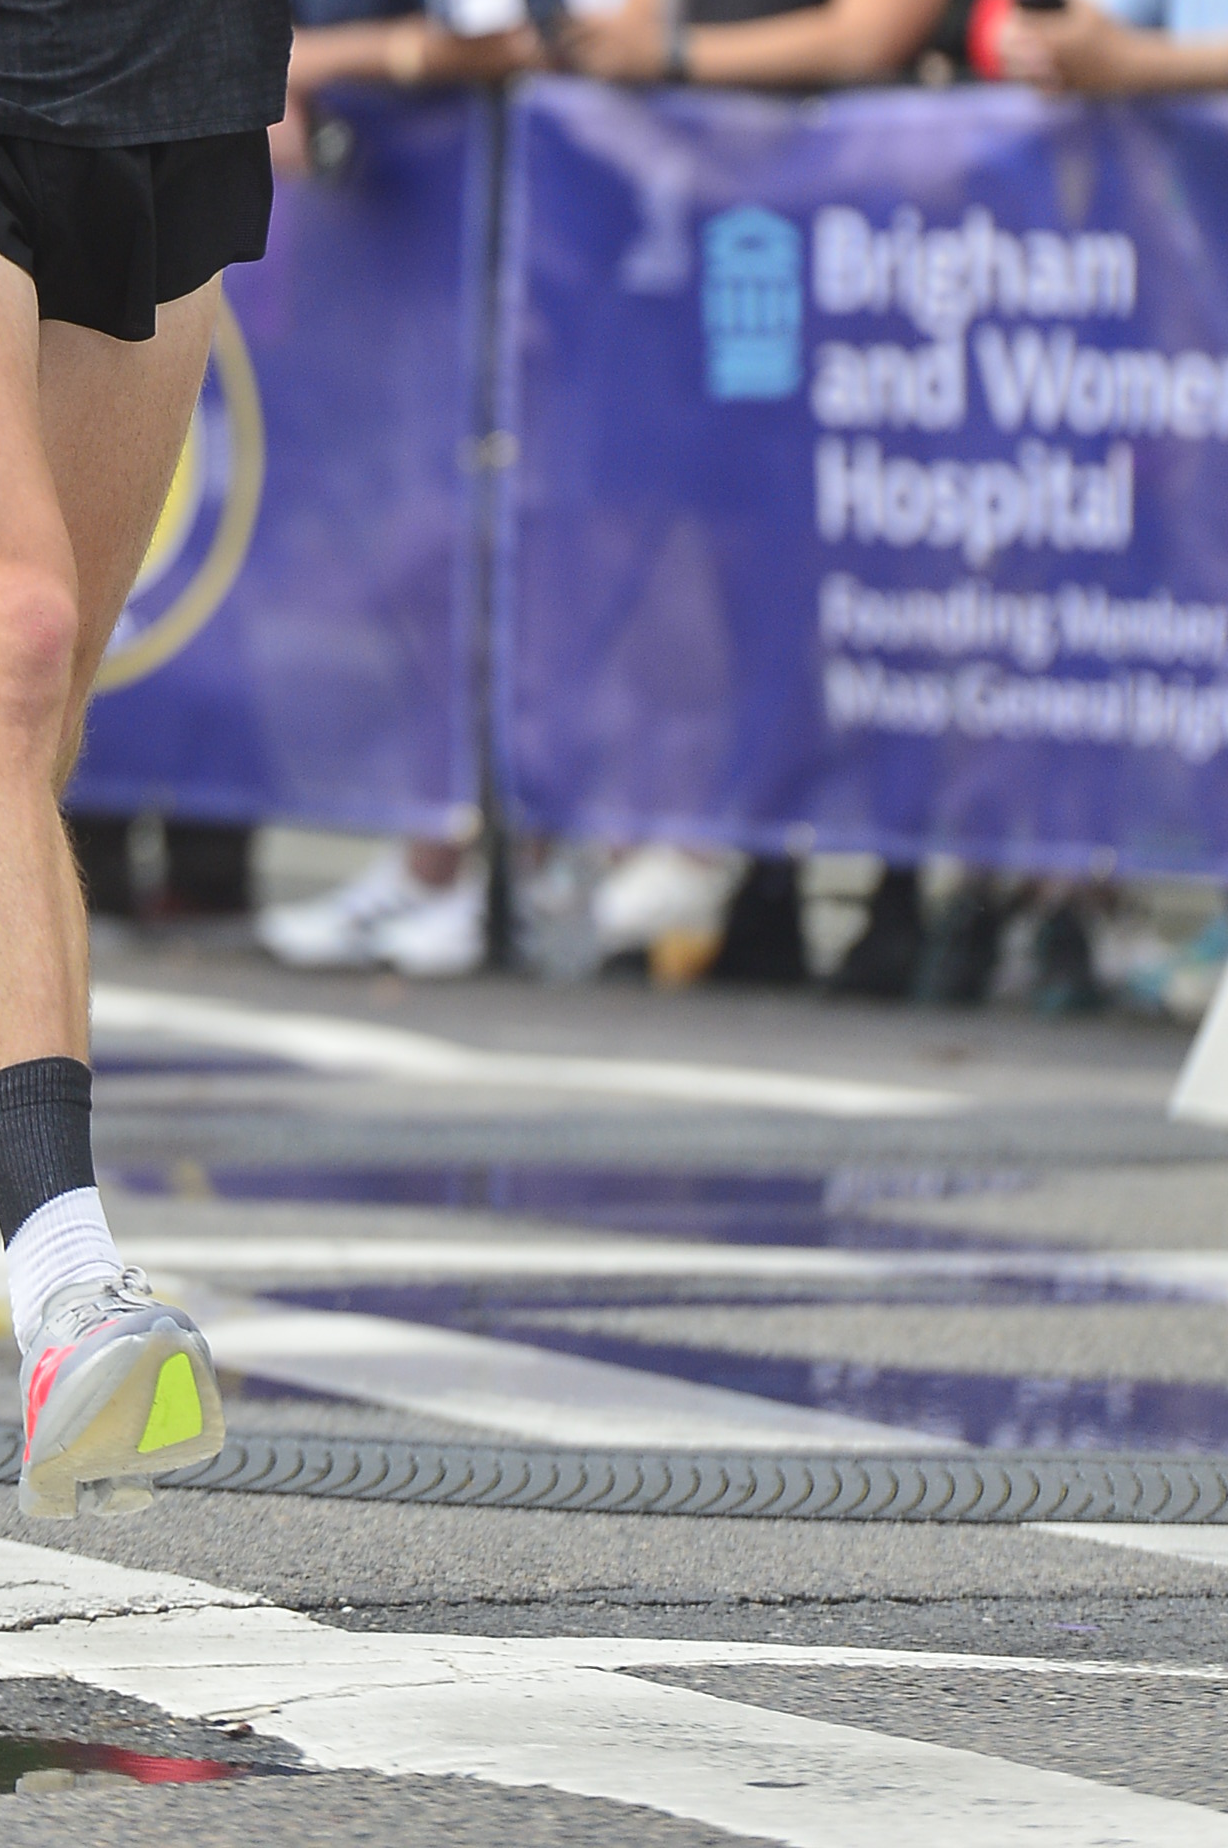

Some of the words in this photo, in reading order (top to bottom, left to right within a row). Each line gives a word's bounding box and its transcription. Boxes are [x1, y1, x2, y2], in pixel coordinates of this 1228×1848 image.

[813, 206, 1136, 333] Brigham
[813, 332, 965, 429] and
[976, 324, 1228, 435] Wome
[818, 439, 1134, 562] Hospital
